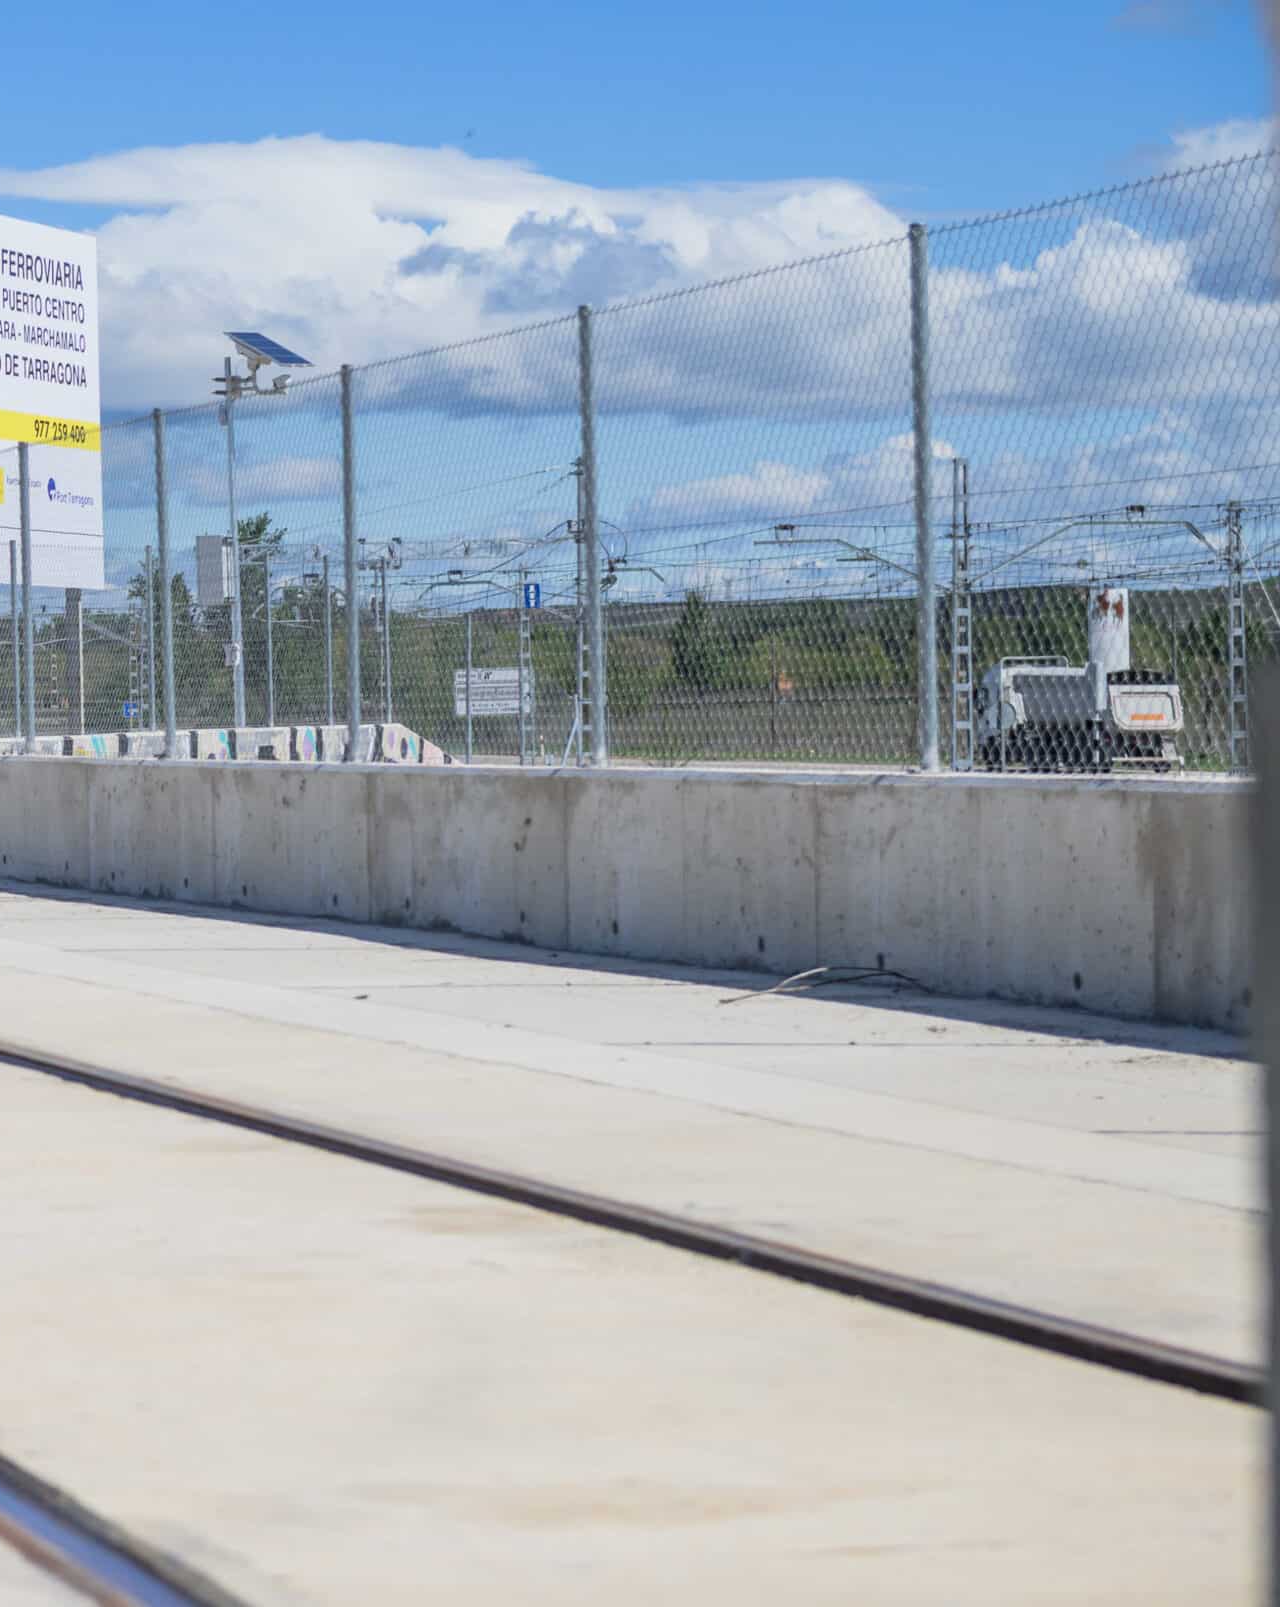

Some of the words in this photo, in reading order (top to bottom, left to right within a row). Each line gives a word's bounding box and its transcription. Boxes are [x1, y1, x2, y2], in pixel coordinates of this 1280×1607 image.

[1, 248, 84, 291] FERROVIARIA
[2, 288, 42, 316] PUERTO
[44, 297, 85, 324] CENTRO
[23, 323, 86, 353] MARCHAMALO
[5, 353, 20, 378] DE
[21, 356, 87, 389] TARRAGONA
[33, 419, 50, 439] 977
[52, 421, 68, 441] 259
[69, 425, 87, 444] 400
